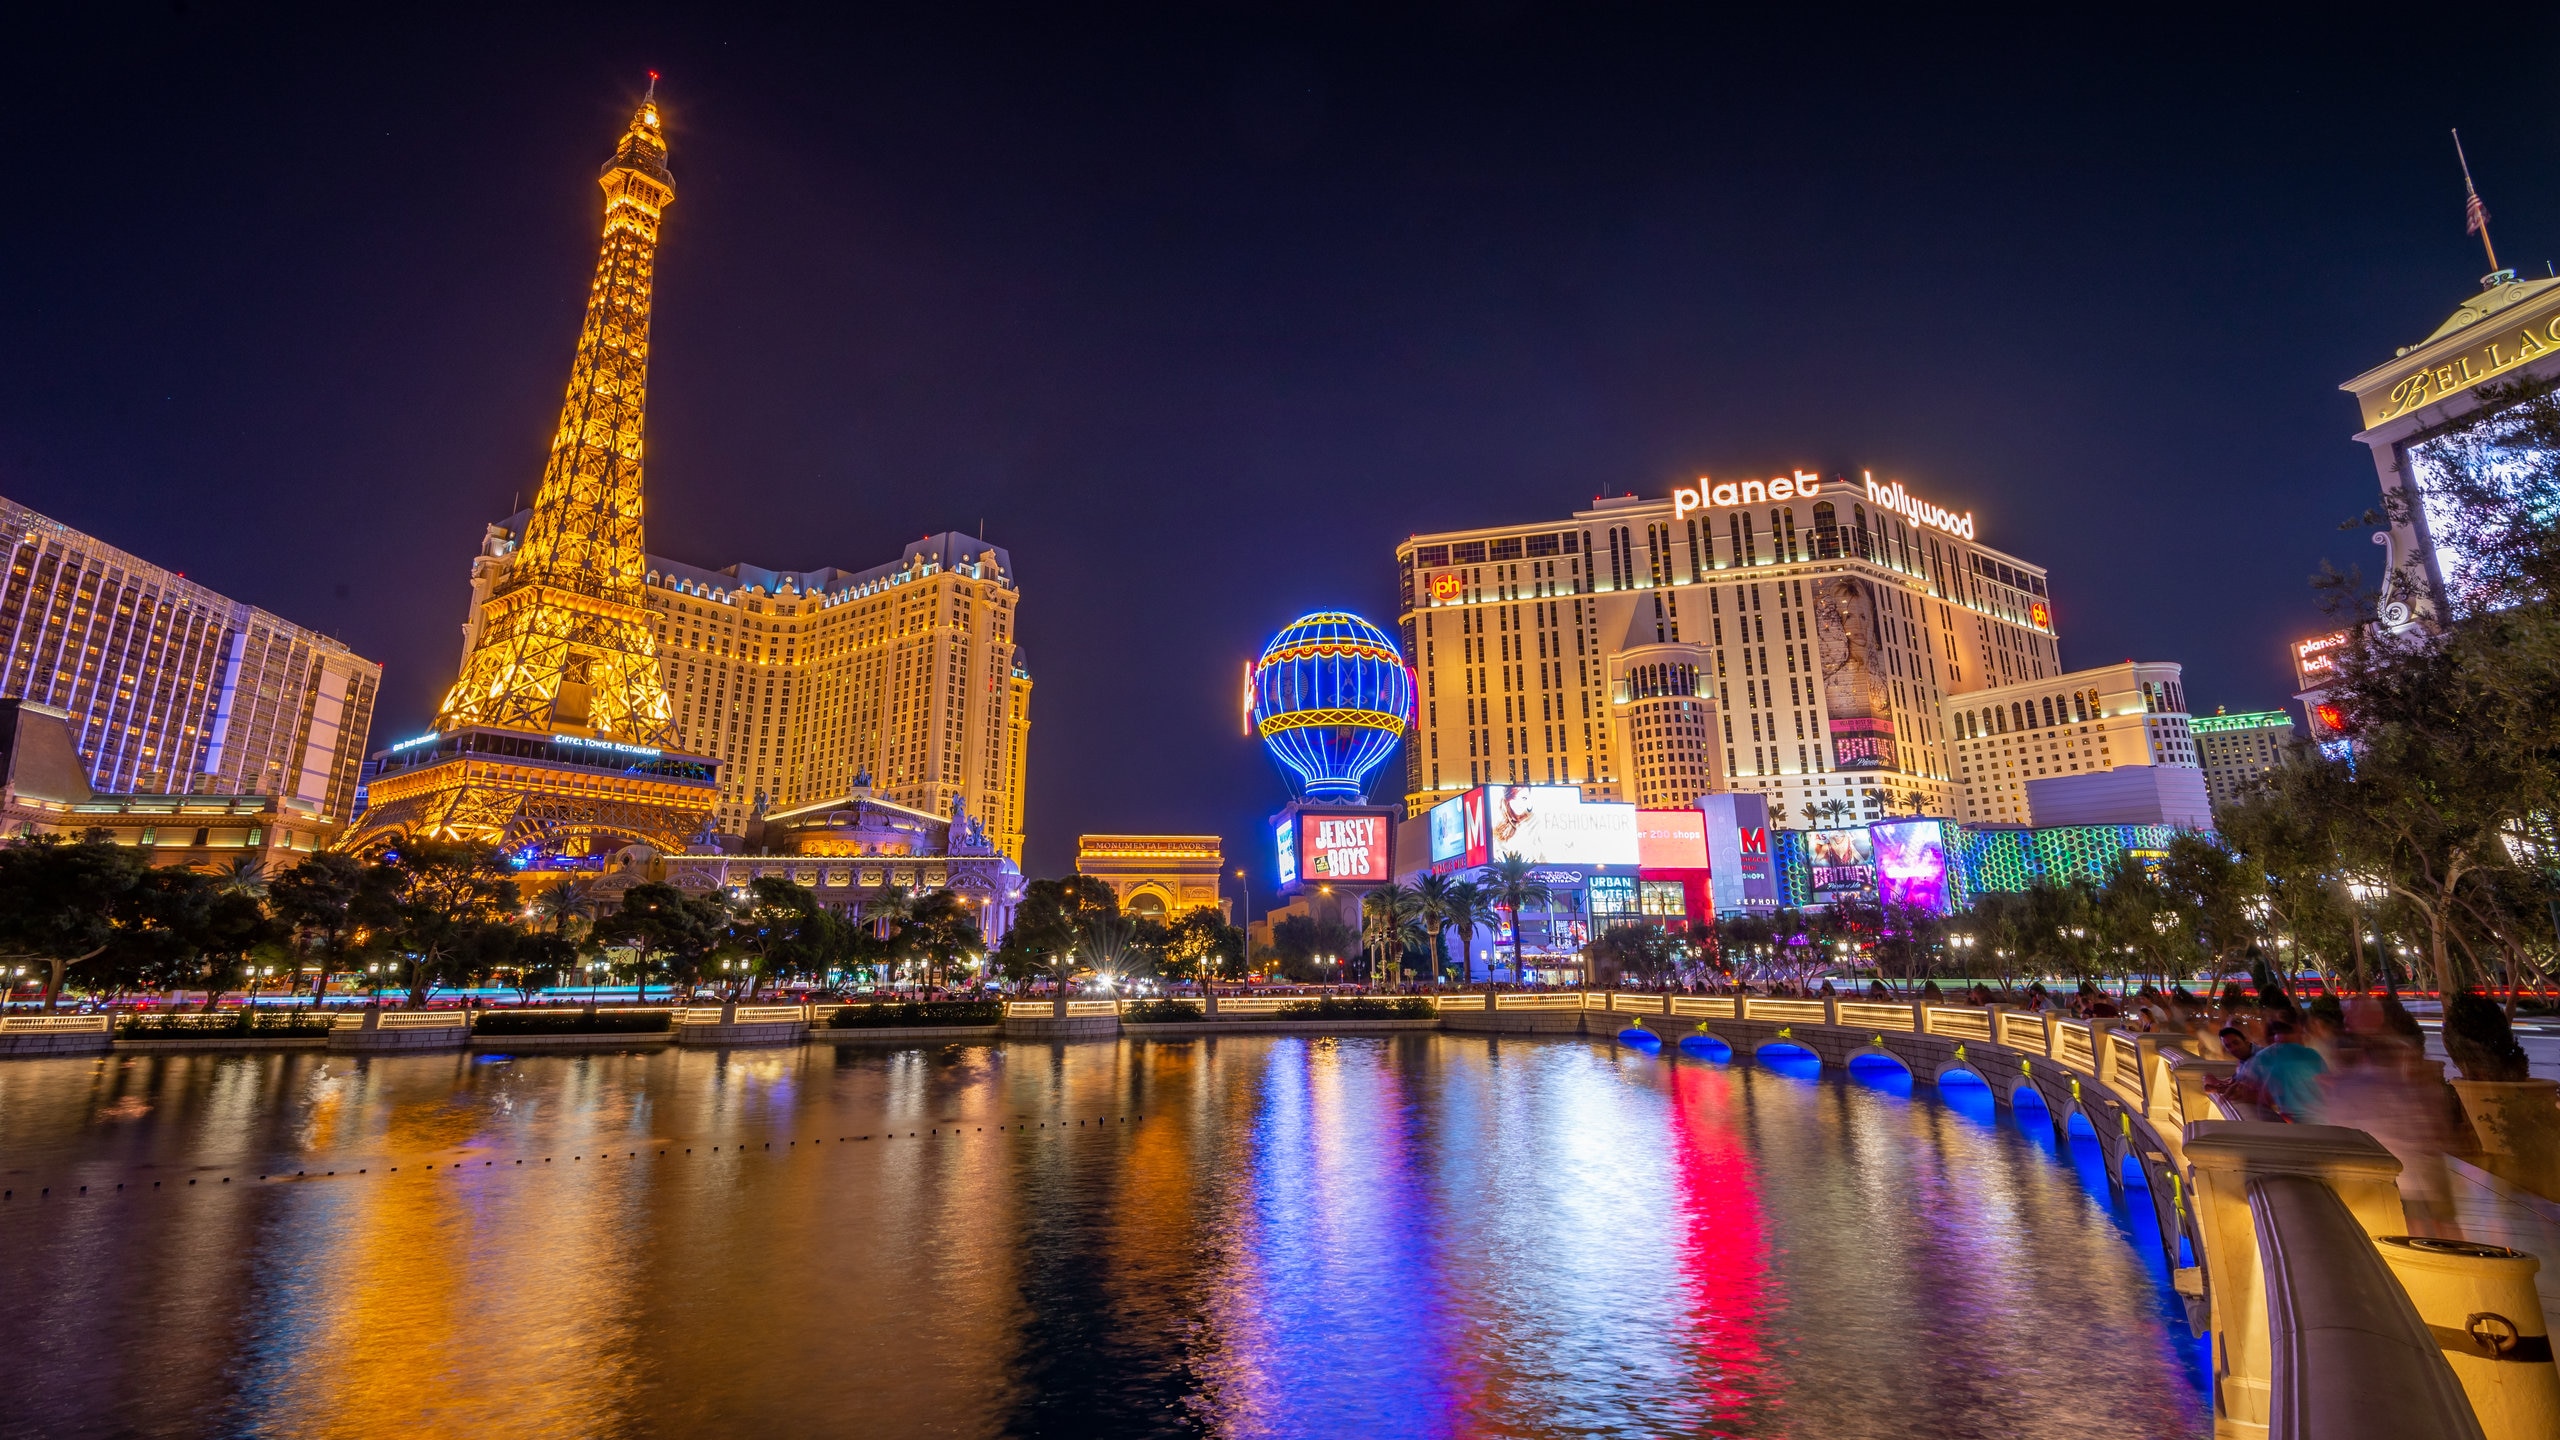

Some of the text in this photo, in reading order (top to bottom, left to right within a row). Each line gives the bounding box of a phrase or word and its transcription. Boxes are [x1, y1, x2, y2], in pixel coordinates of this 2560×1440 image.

[1673, 470, 1820, 520] planet
[1864, 470, 1975, 541] hollywood
[555, 734, 661, 756] EIFFEL TOWER RESTAURANT
[1837, 737, 1896, 765] BRITNEY
[1315, 818, 1375, 849] JERSEY
[1465, 796, 1485, 851] M
[1544, 812, 1630, 831] FASHIONATOR
[1096, 842, 1206, 850] MONUMENTAL FLAVORS
[1650, 830, 1670, 839] 200
[1672, 830, 1701, 841] shops
[1738, 826, 1767, 855] M
[1327, 847, 1370, 877] BOYS
[1589, 877, 1631, 887] URBAN
[1812, 864, 1873, 889] BRITNEY
[1591, 889, 1633, 899] OUTFIT
